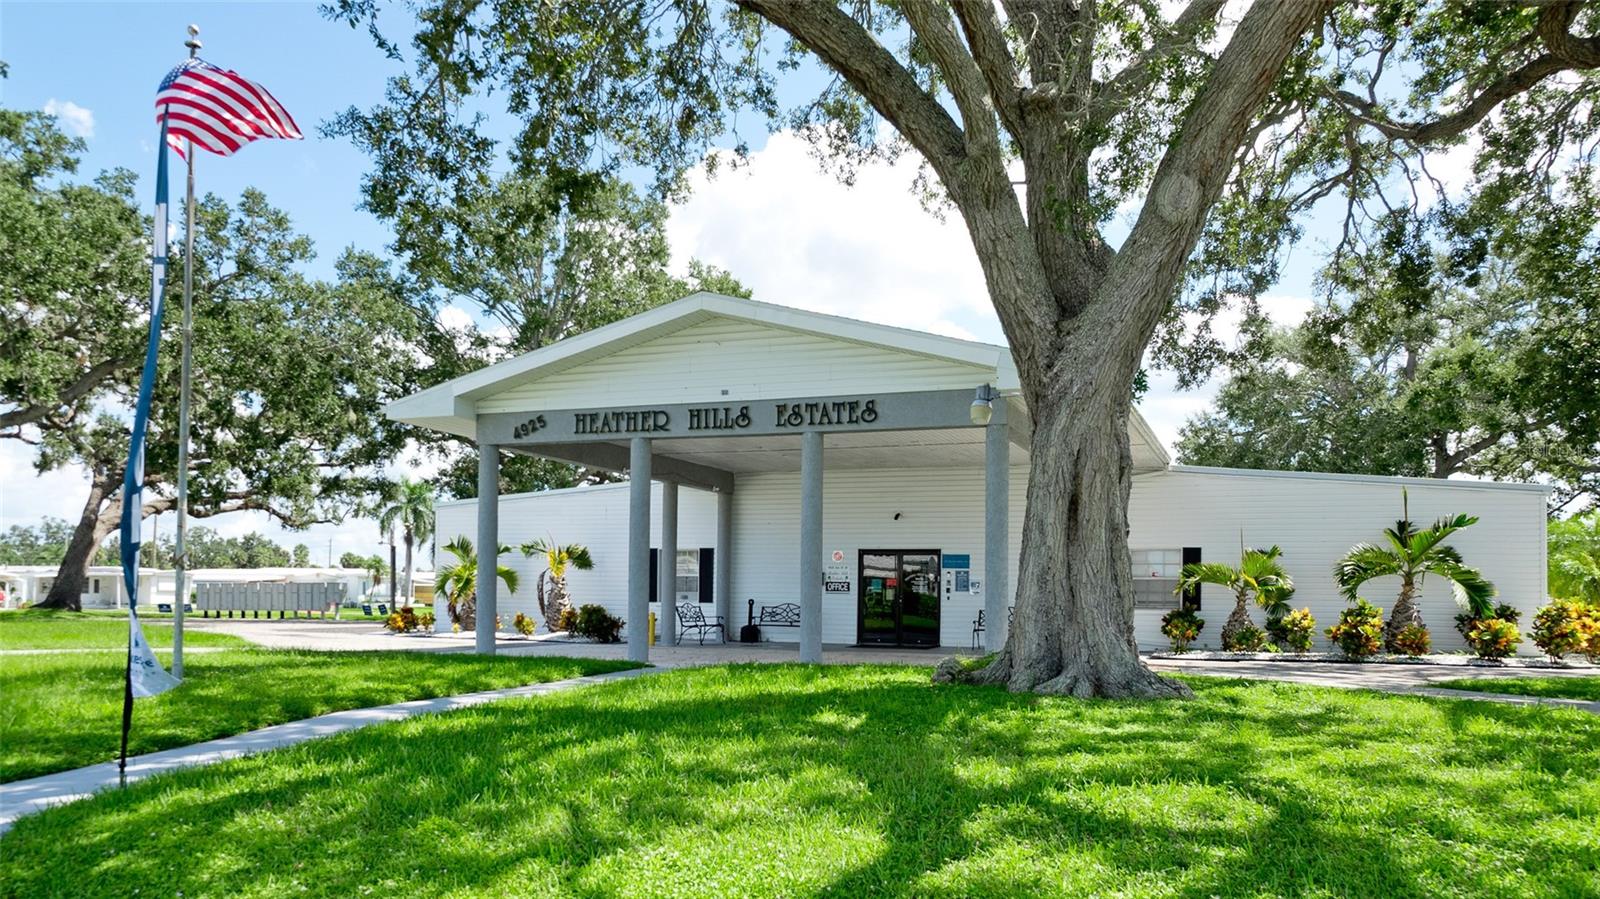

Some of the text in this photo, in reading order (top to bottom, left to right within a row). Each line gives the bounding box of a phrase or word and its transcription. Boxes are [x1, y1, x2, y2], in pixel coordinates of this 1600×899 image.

[513, 414, 547, 440] 4925
[574, 399, 878, 434] HEATHER HILLS ESTATES
[827, 582, 849, 591] OFFICE
